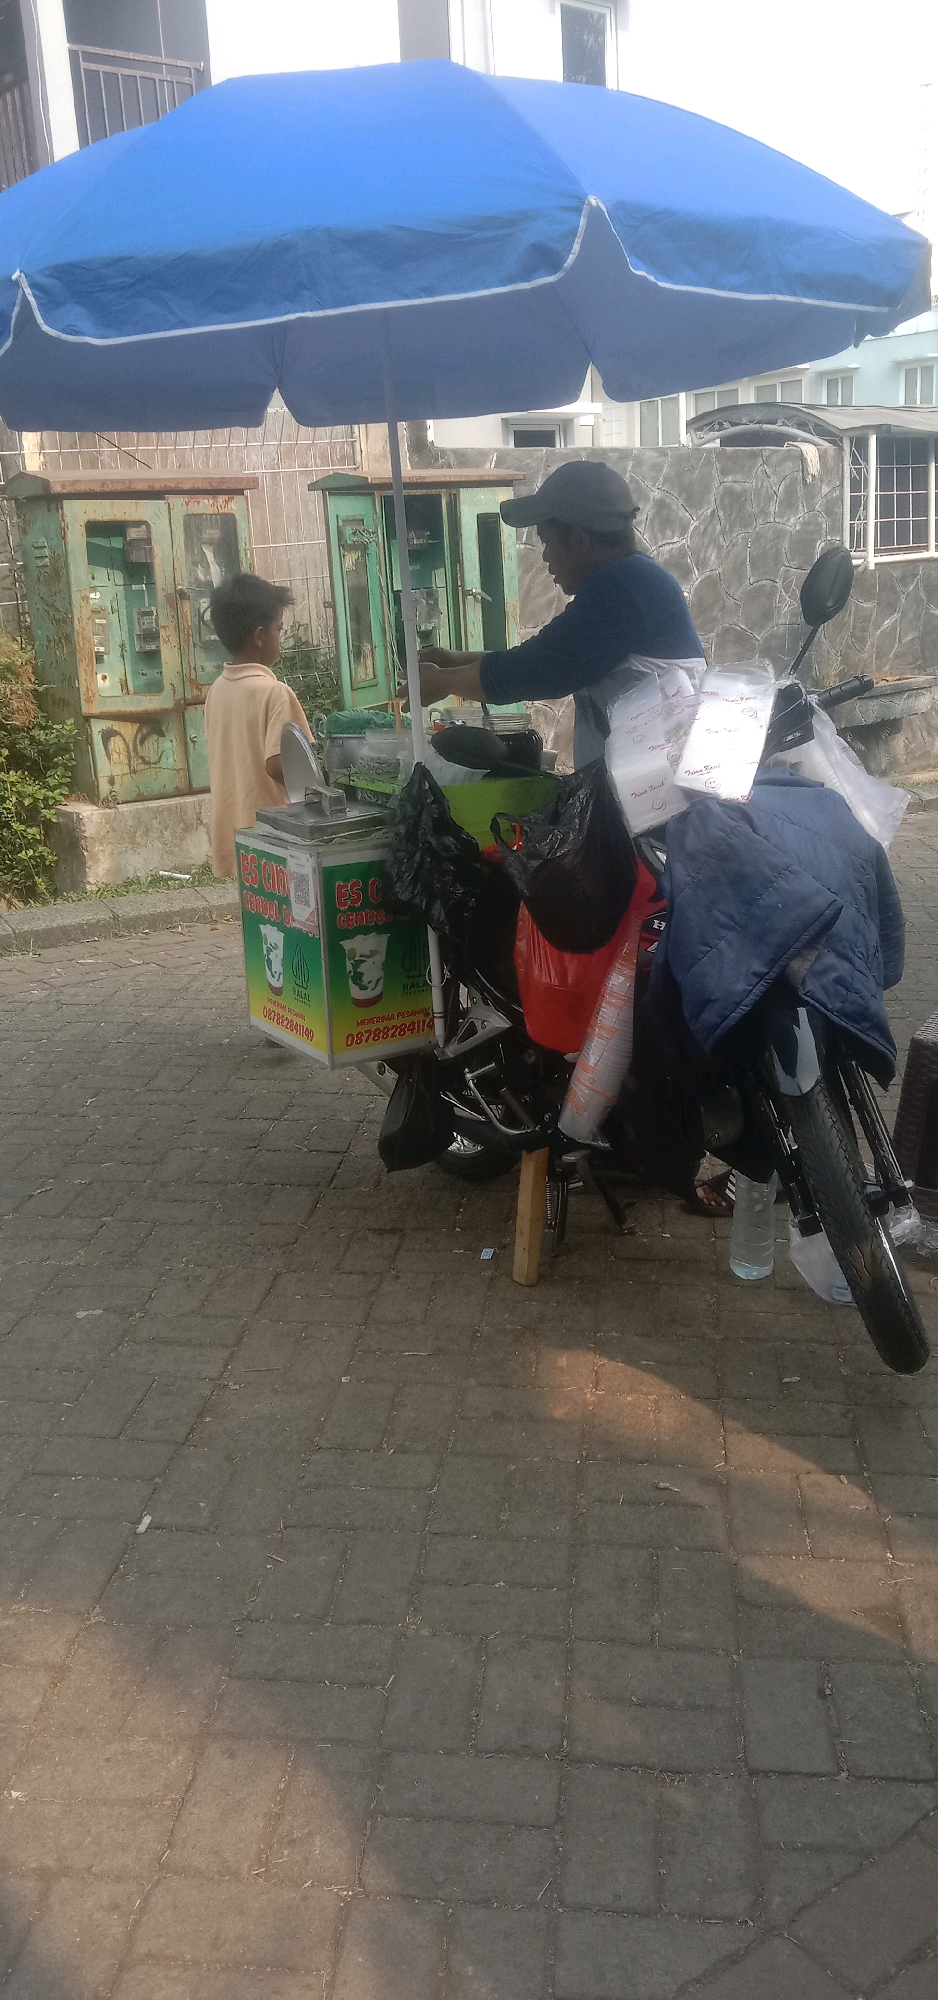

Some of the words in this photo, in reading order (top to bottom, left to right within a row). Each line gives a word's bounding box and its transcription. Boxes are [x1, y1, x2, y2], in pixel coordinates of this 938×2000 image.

[240, 850, 259, 888] ES
[336, 878, 362, 910] ES
[402, 979, 431, 992] HALA
[345, 1017, 435, 1048] 08788284114
